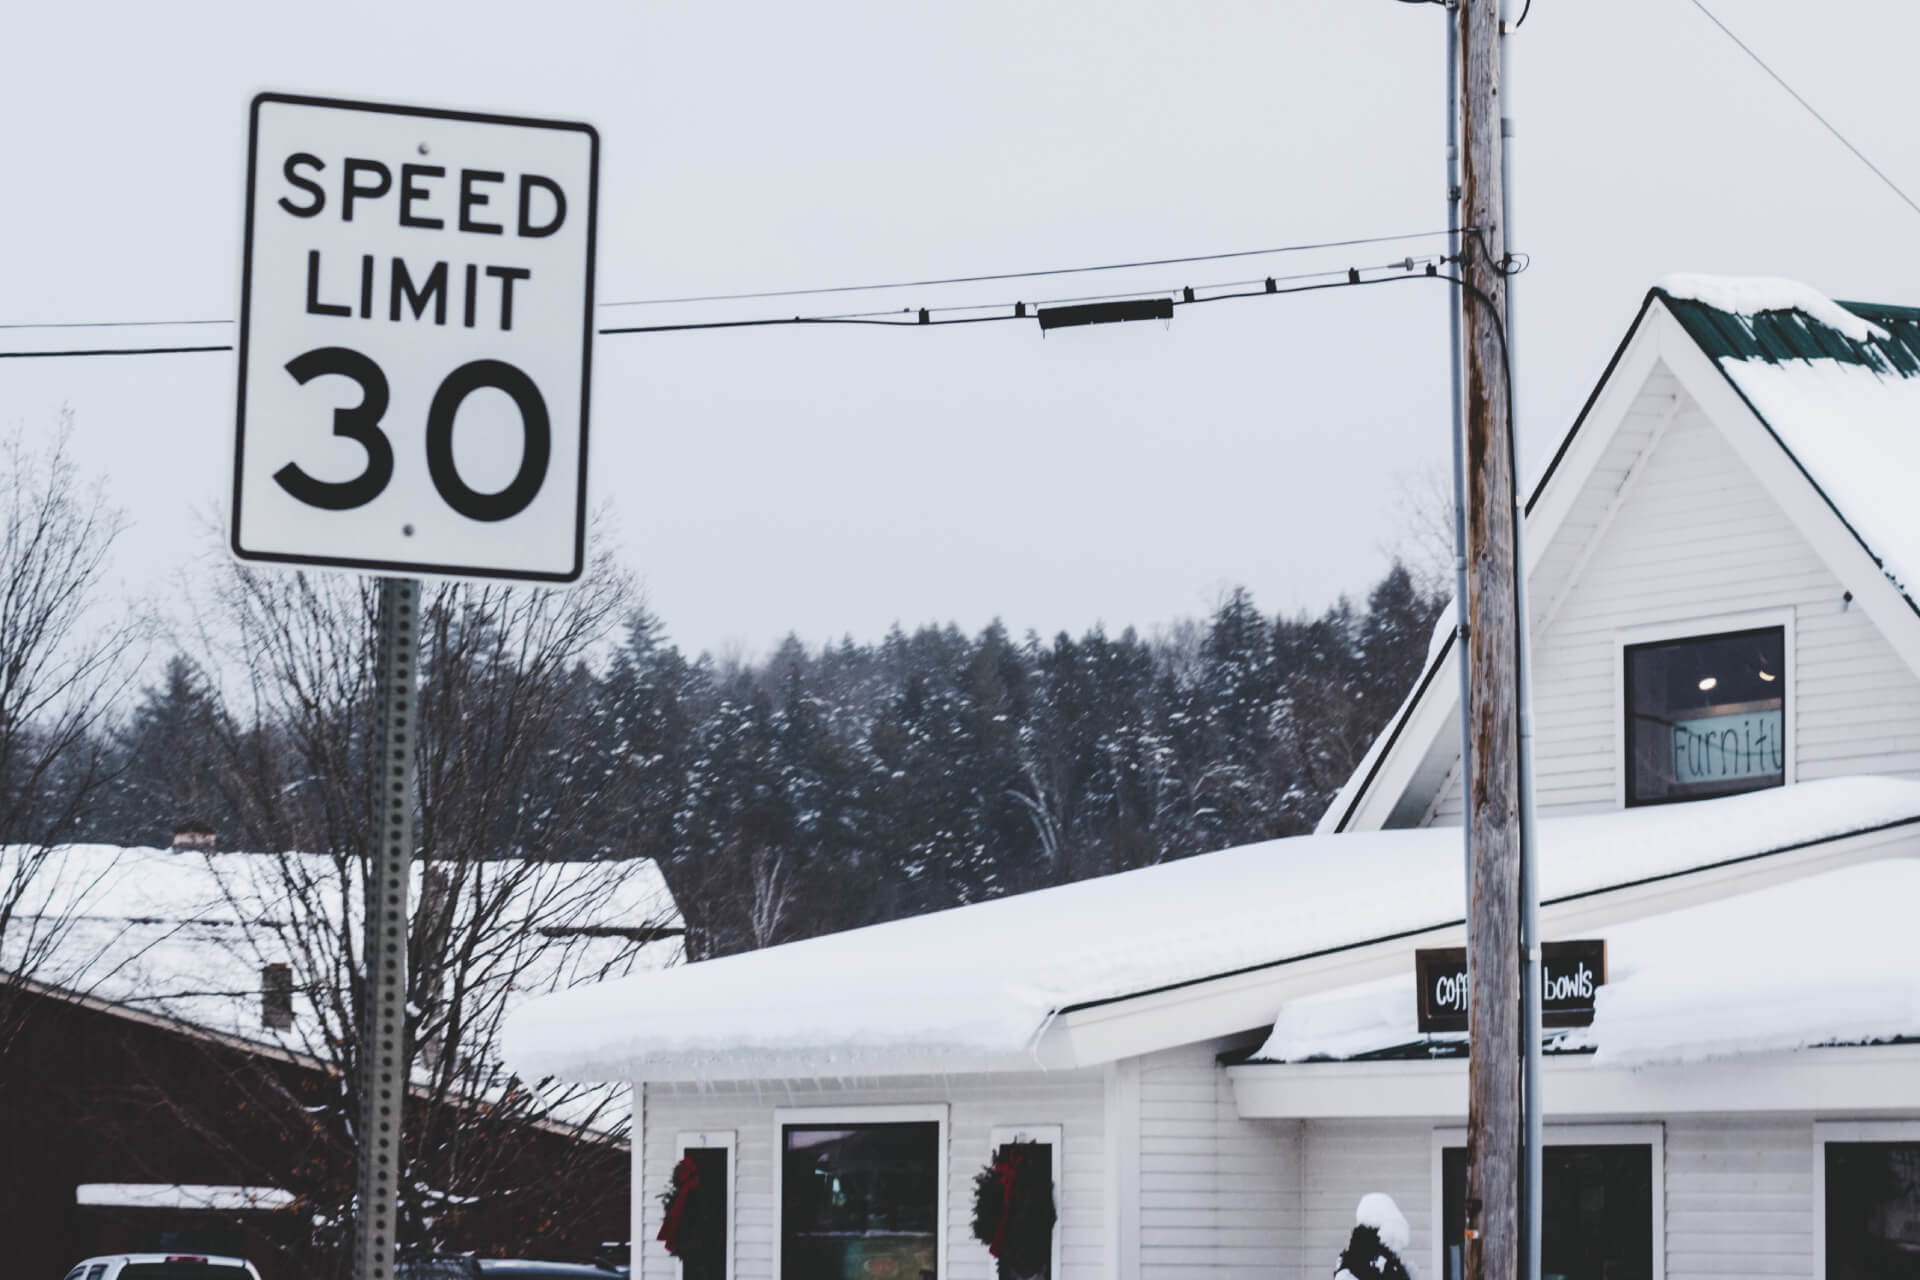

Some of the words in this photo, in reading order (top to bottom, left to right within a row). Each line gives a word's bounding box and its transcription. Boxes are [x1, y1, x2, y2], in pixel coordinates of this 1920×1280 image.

[277, 150, 567, 239] SPEED
[306, 249, 531, 331] LIMIT
[272, 346, 551, 522] 30
[1544, 961, 1593, 1000] bowls
